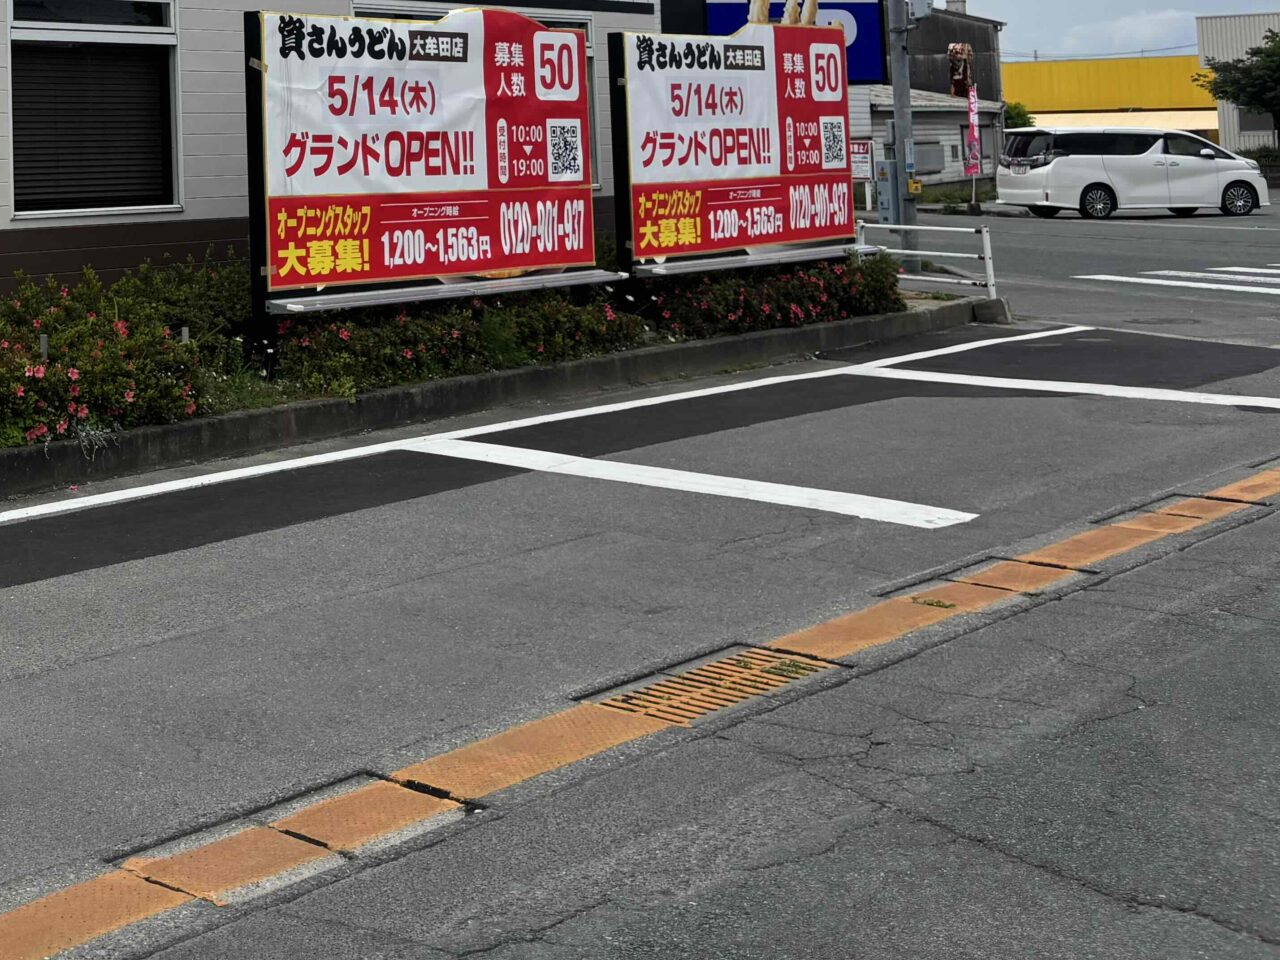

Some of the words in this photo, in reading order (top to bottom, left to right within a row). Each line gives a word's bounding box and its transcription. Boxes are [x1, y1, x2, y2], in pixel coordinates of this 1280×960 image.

[278, 15, 406, 61] 資さんうどん
[412, 36, 464, 59] 大牟田店
[637, 35, 721, 72] 資さんうどん
[539, 43, 574, 91] 50
[725, 48, 762, 68] 大牟田店
[815, 52, 839, 93] 50
[327, 74, 436, 117] 5/14(木)
[671, 83, 745, 117] 5/14(木)
[511, 125, 543, 143] 10:00
[796, 122, 818, 137] 10:00
[282, 130, 475, 178] グランドOPEN!!
[641, 127, 771, 168] グランドOPEN!!
[797, 150, 820, 165] 19:00
[512, 158, 544, 176] 19:00
[277, 205, 371, 238] オープニングスタッフ
[411, 205, 460, 217] オープニング時給
[639, 190, 702, 218] オープニングスタッフ
[789, 183, 848, 230] 0120-901-937
[500, 200, 585, 256] 0120-901-937
[278, 239, 370, 277] 大募集!
